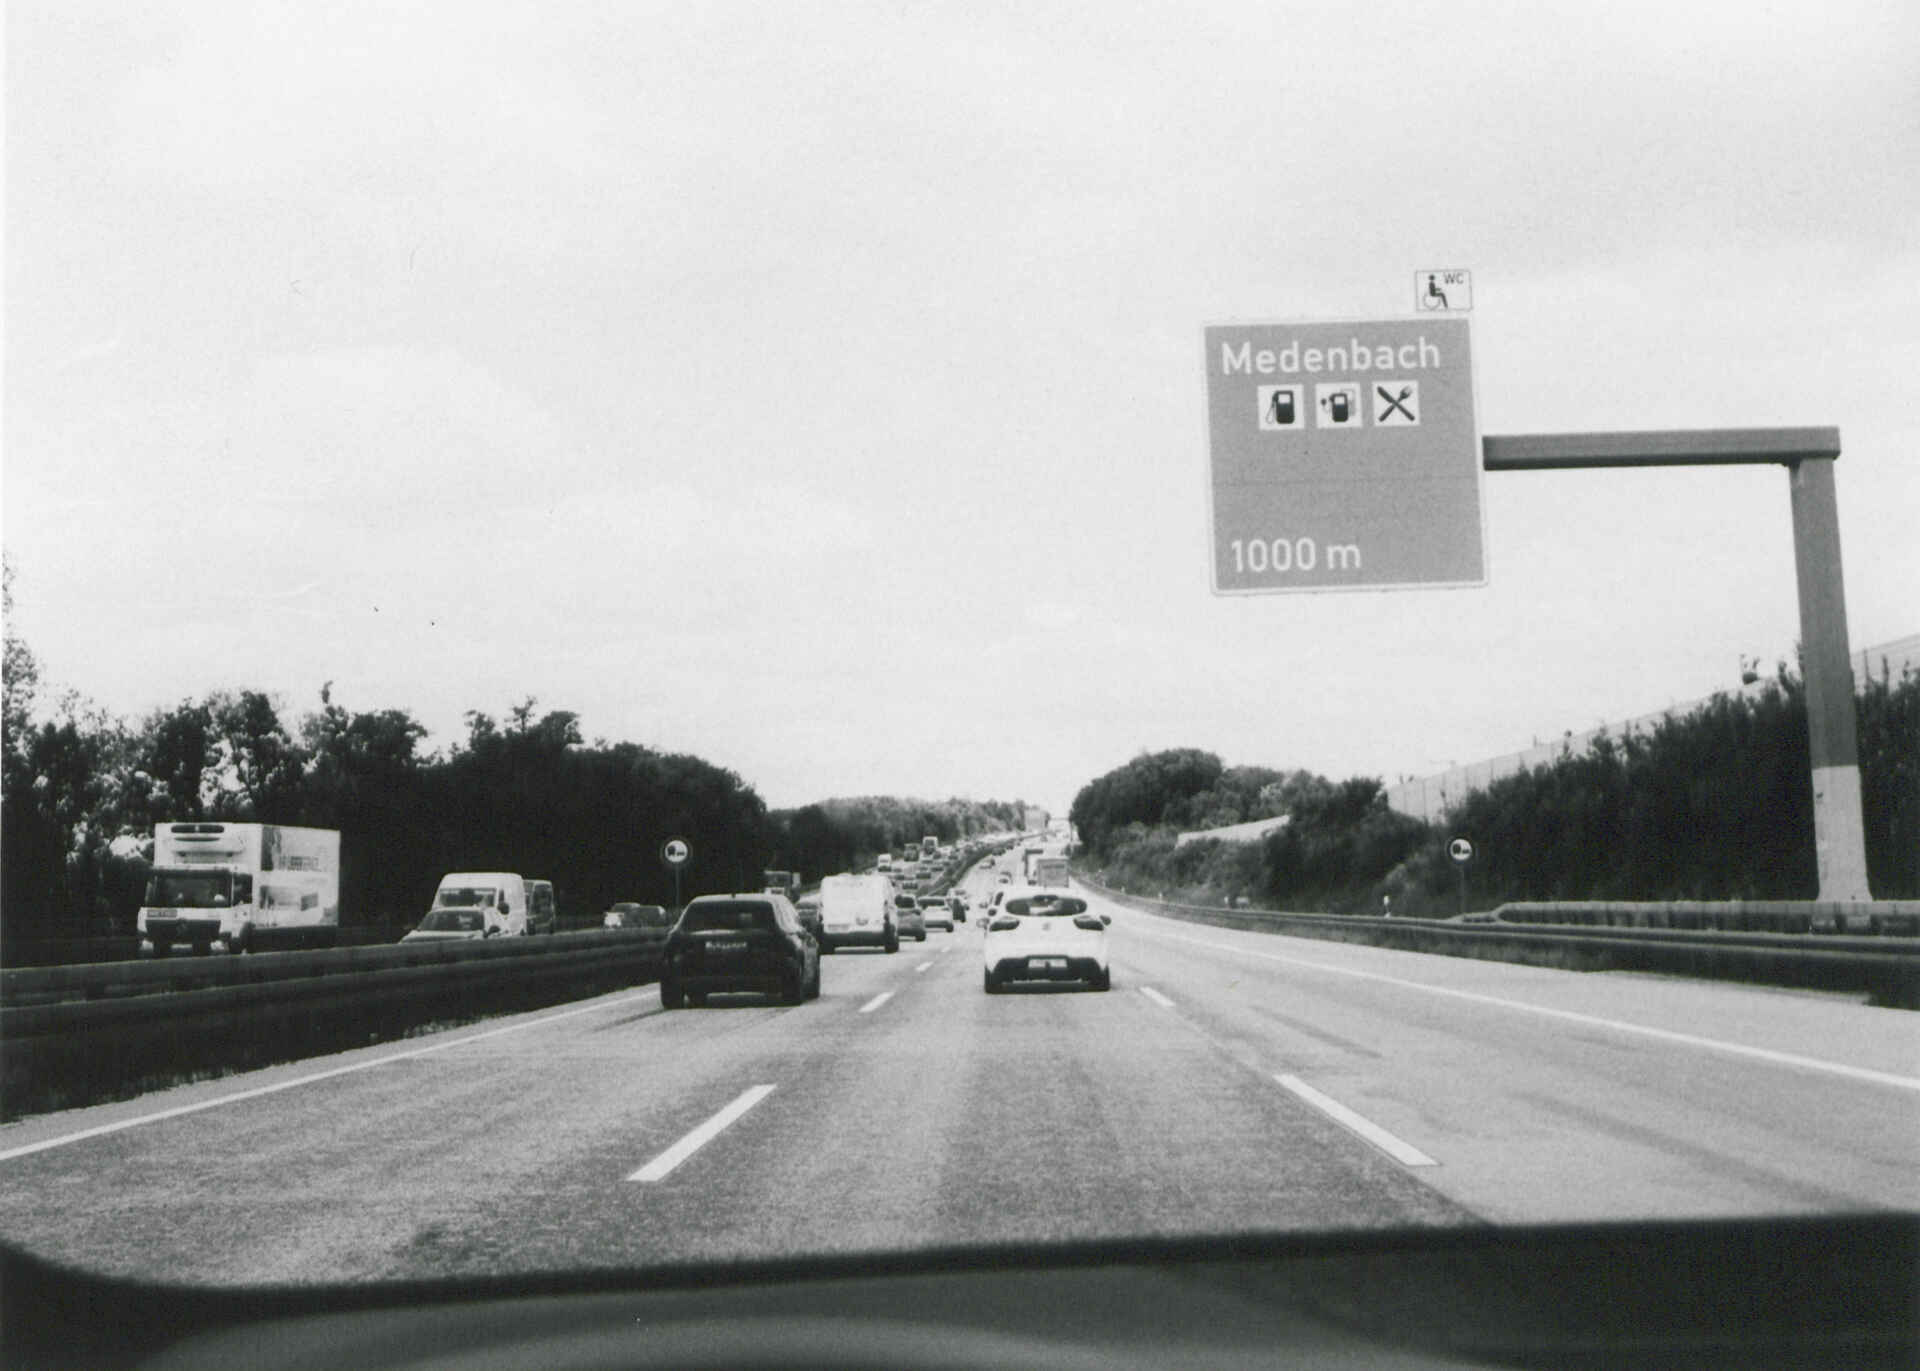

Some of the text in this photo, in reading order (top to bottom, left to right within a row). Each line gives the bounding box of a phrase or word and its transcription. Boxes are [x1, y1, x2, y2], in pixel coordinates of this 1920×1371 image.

[1443, 272, 1465, 285] WC
[1221, 337, 1441, 375] Medenbach
[1231, 538, 1361, 573] 1000 m
